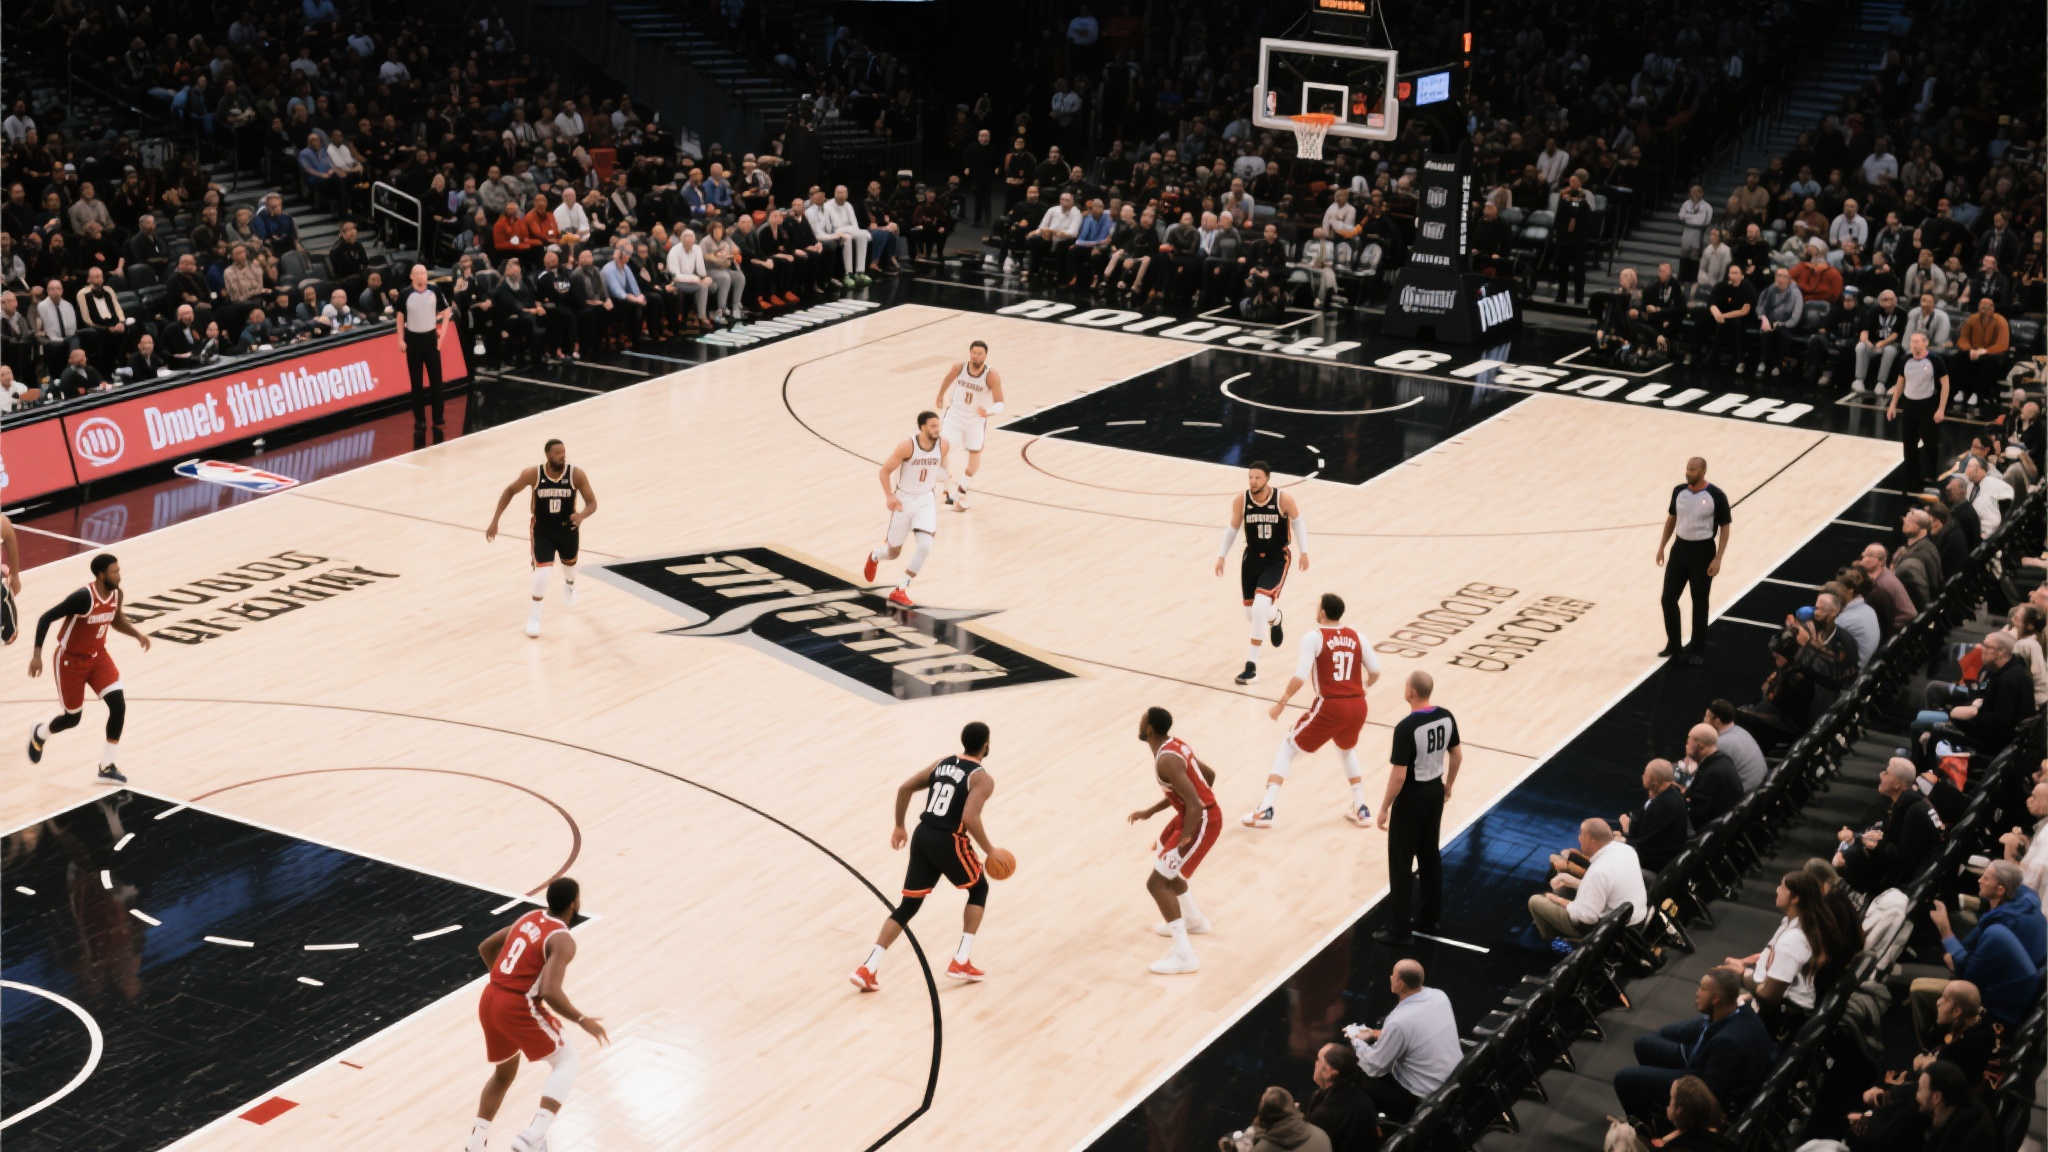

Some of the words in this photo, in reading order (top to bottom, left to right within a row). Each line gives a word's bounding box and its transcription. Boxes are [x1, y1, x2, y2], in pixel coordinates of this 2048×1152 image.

[1333, 650, 1354, 681] 37
[926, 781, 956, 817] 18
[500, 937, 527, 974] 9
